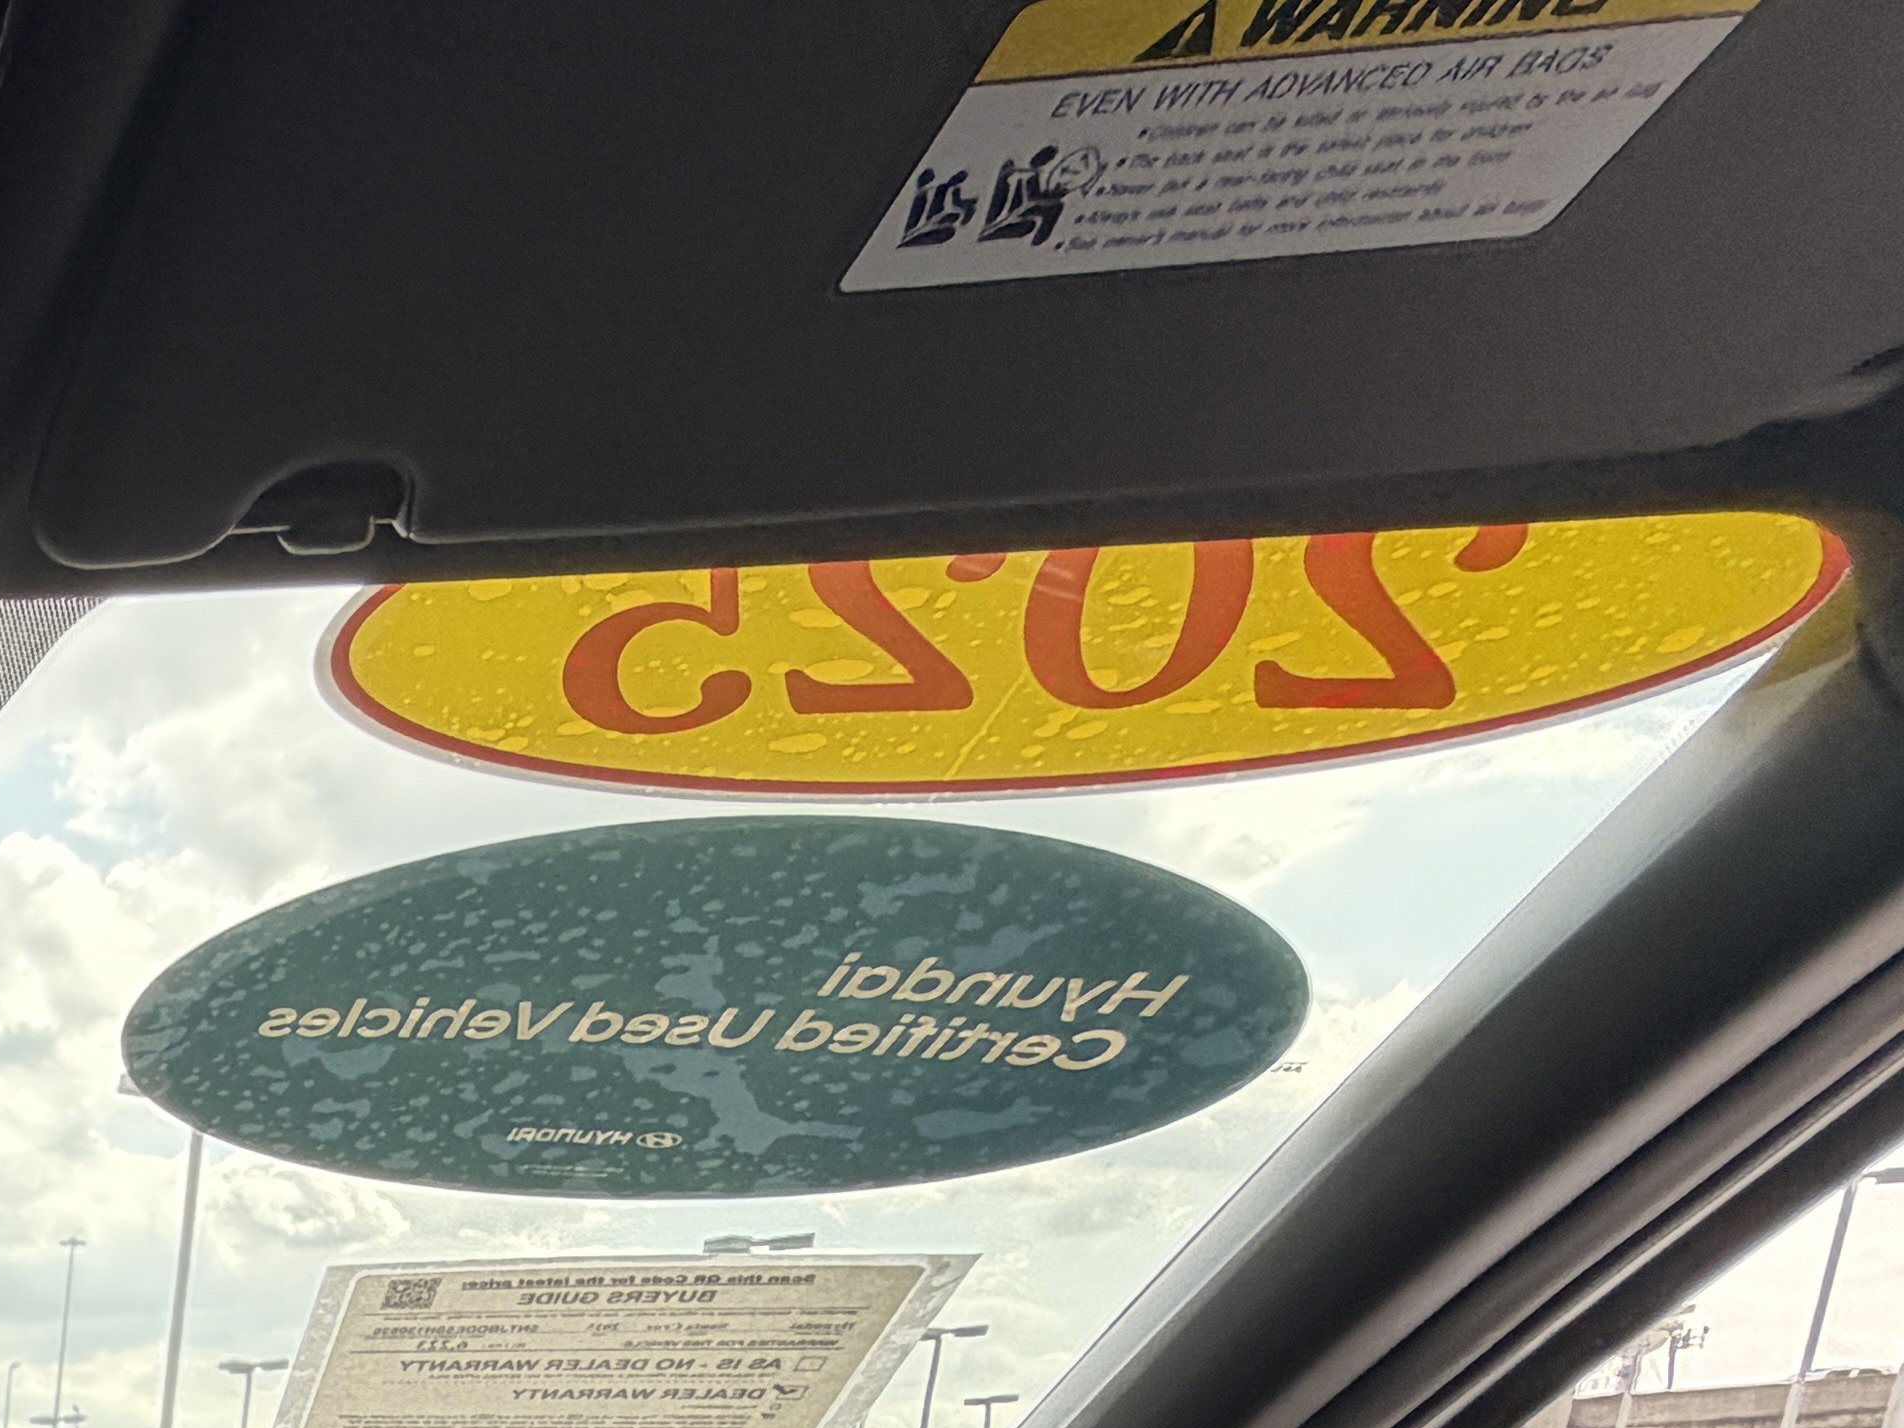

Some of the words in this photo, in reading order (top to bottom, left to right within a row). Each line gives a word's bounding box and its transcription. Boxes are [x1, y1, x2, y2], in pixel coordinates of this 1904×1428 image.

[1051, 87, 1147, 118] EVEN
[1153, 79, 1242, 111] WITH
[1243, 62, 1433, 101] ADVANCED
[1438, 55, 1504, 82] AIR
